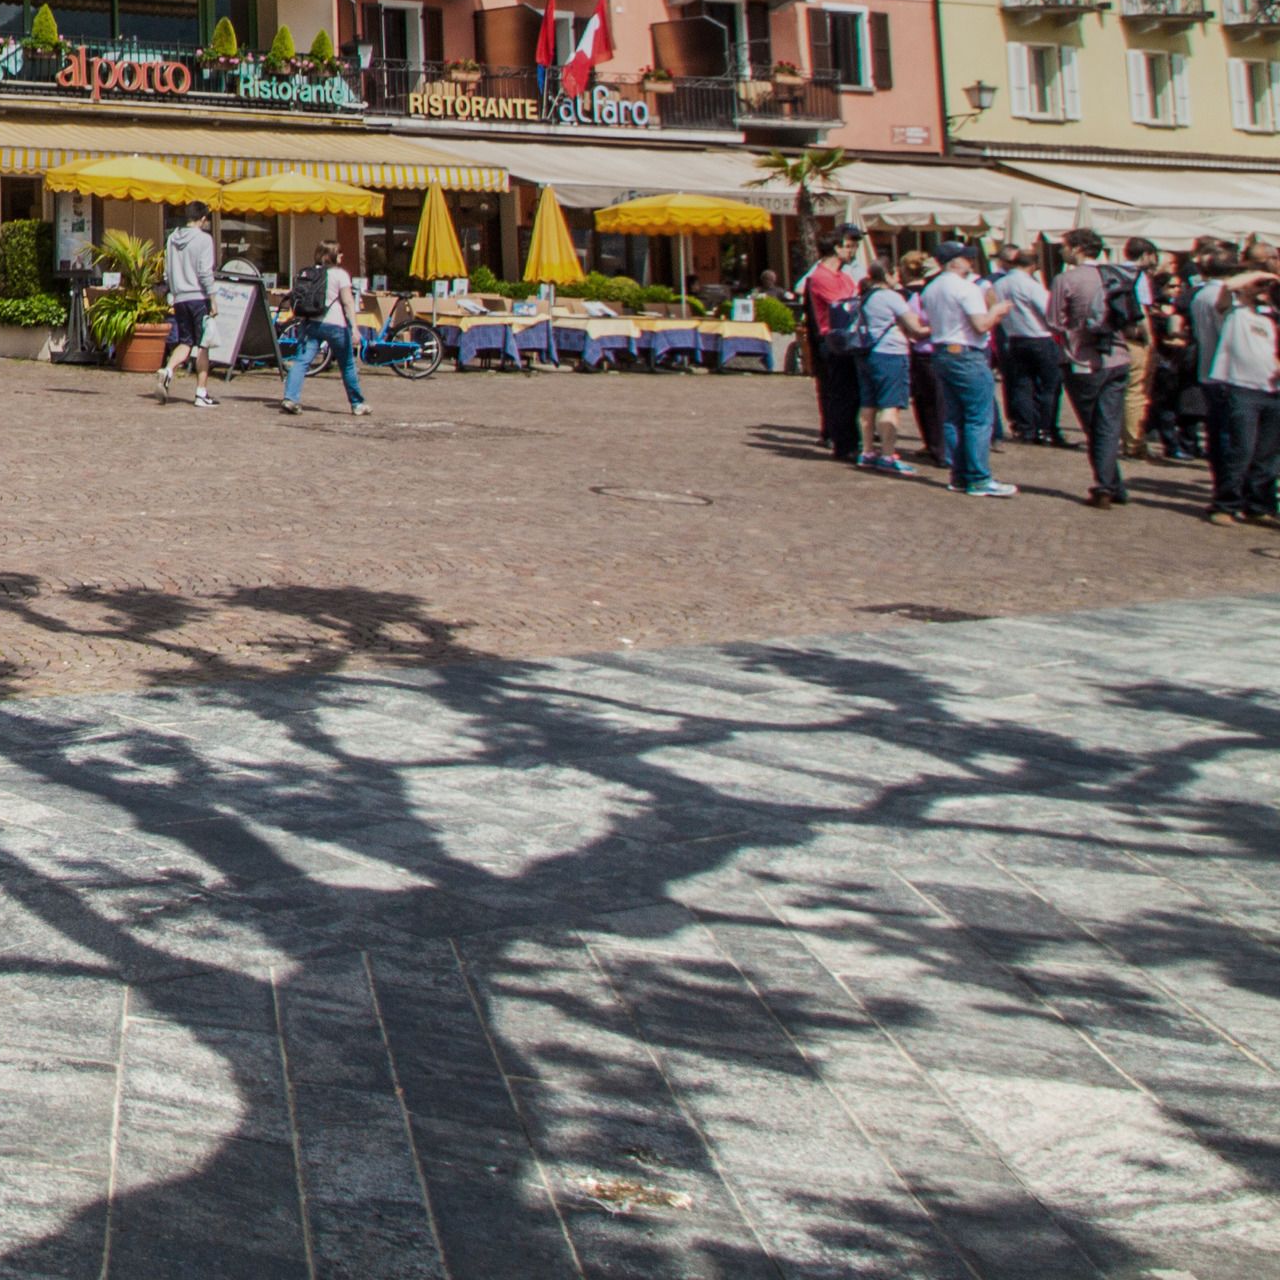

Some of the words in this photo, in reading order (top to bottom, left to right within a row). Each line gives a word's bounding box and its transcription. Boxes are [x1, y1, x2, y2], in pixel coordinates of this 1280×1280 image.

[56, 45, 88, 87] al
[91, 55, 192, 102] porto
[239, 73, 346, 106] Ristorante
[409, 92, 538, 120] RISTORANTE
